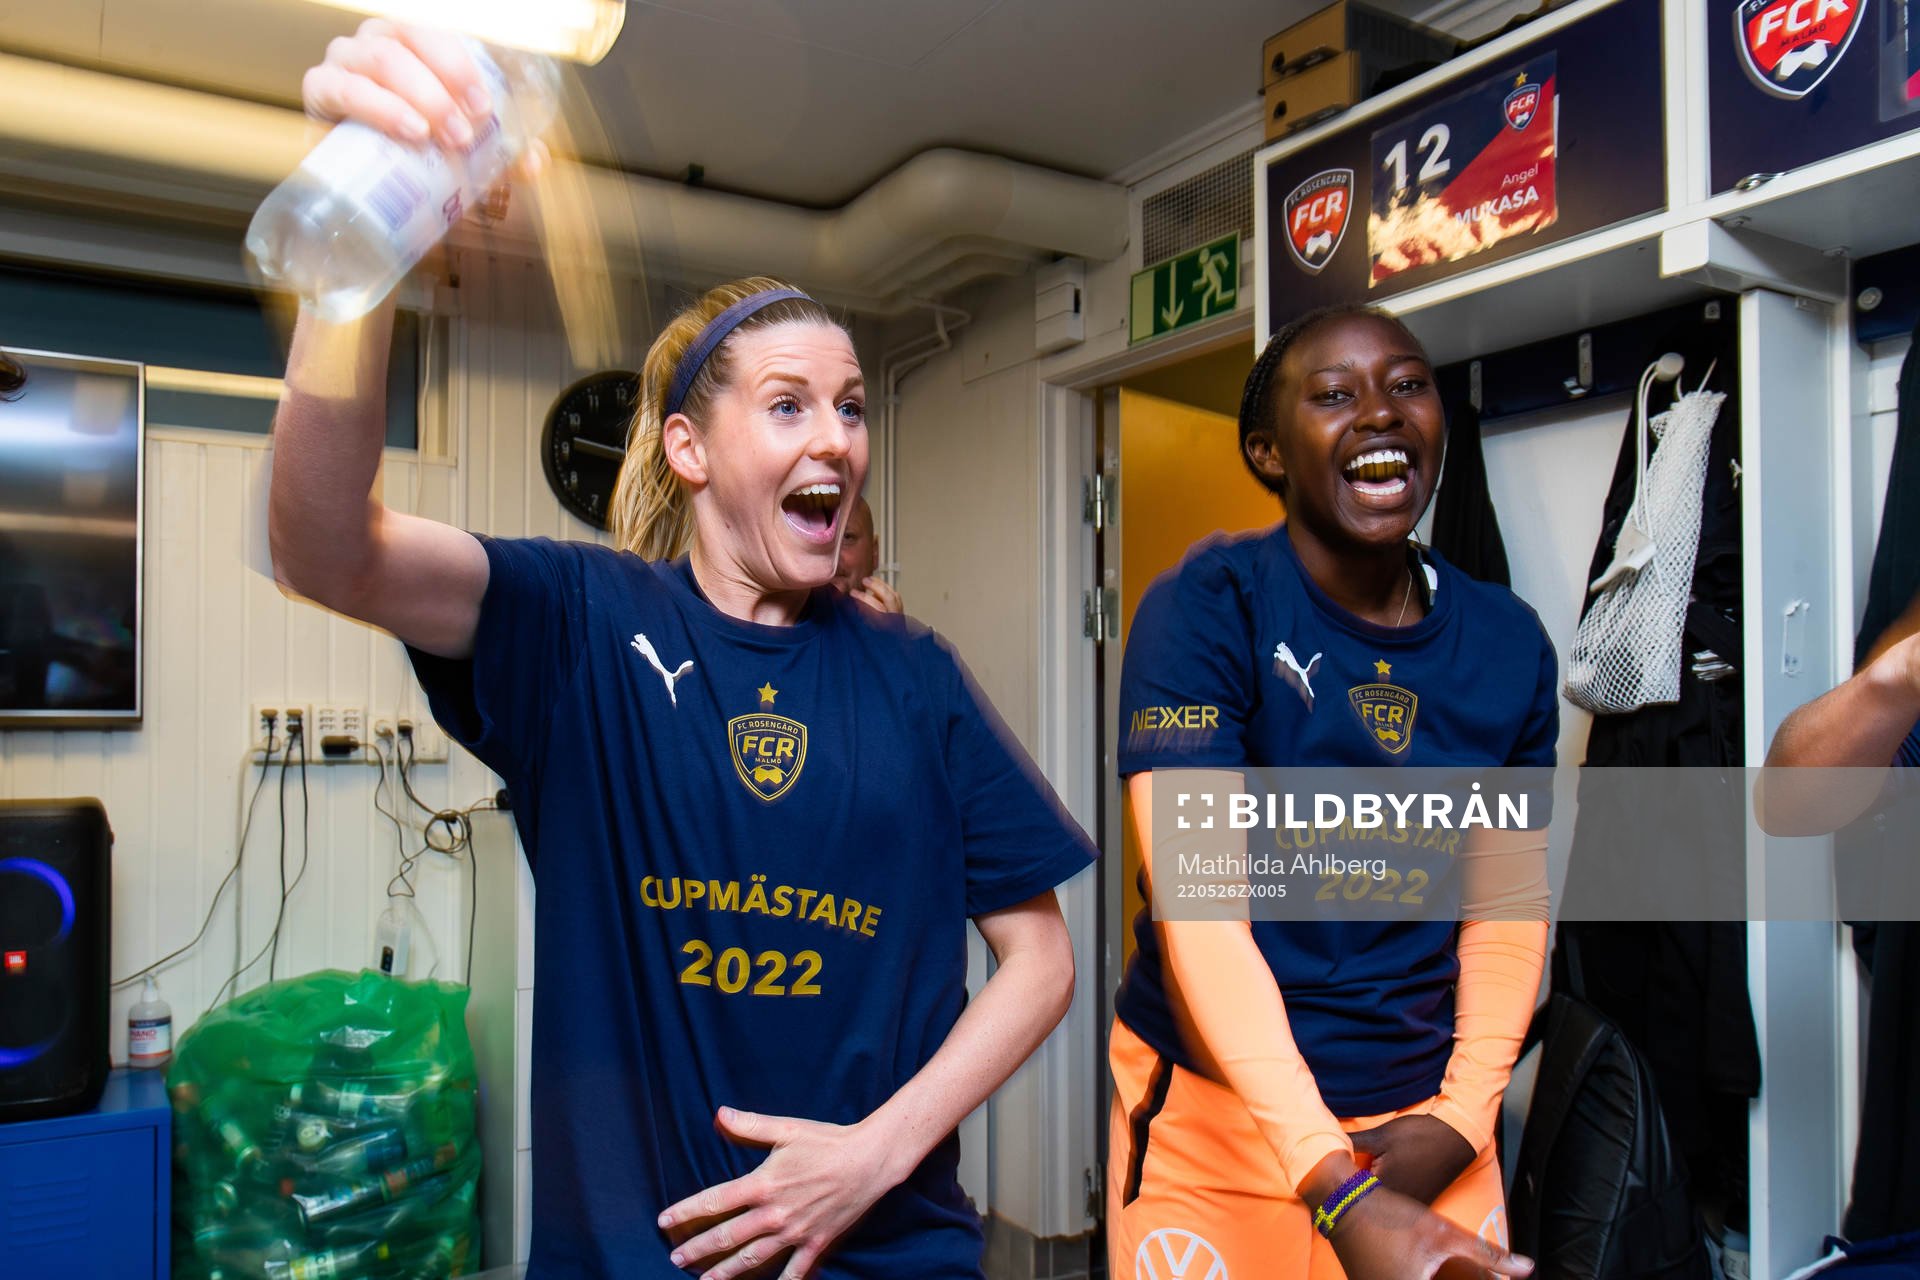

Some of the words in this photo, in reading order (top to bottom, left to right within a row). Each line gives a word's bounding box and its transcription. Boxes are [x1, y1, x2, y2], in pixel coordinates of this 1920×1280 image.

[1384, 123, 1451, 190] 12
[1502, 163, 1538, 187] Angel
[1294, 190, 1343, 230] FCR
[1455, 186, 1539, 226] MUKASA
[569, 413, 581, 426] 10
[561, 441, 569, 455] 9
[737, 722, 748, 731] FC
[748, 720, 799, 735] ROSENGÅRD
[1362, 703, 1404, 723] FCR
[742, 735, 795, 757] FCR
[1314, 867, 1430, 904] 2022
[640, 874, 882, 938] CUPMÄSTARE
[680, 939, 823, 996] 2022
